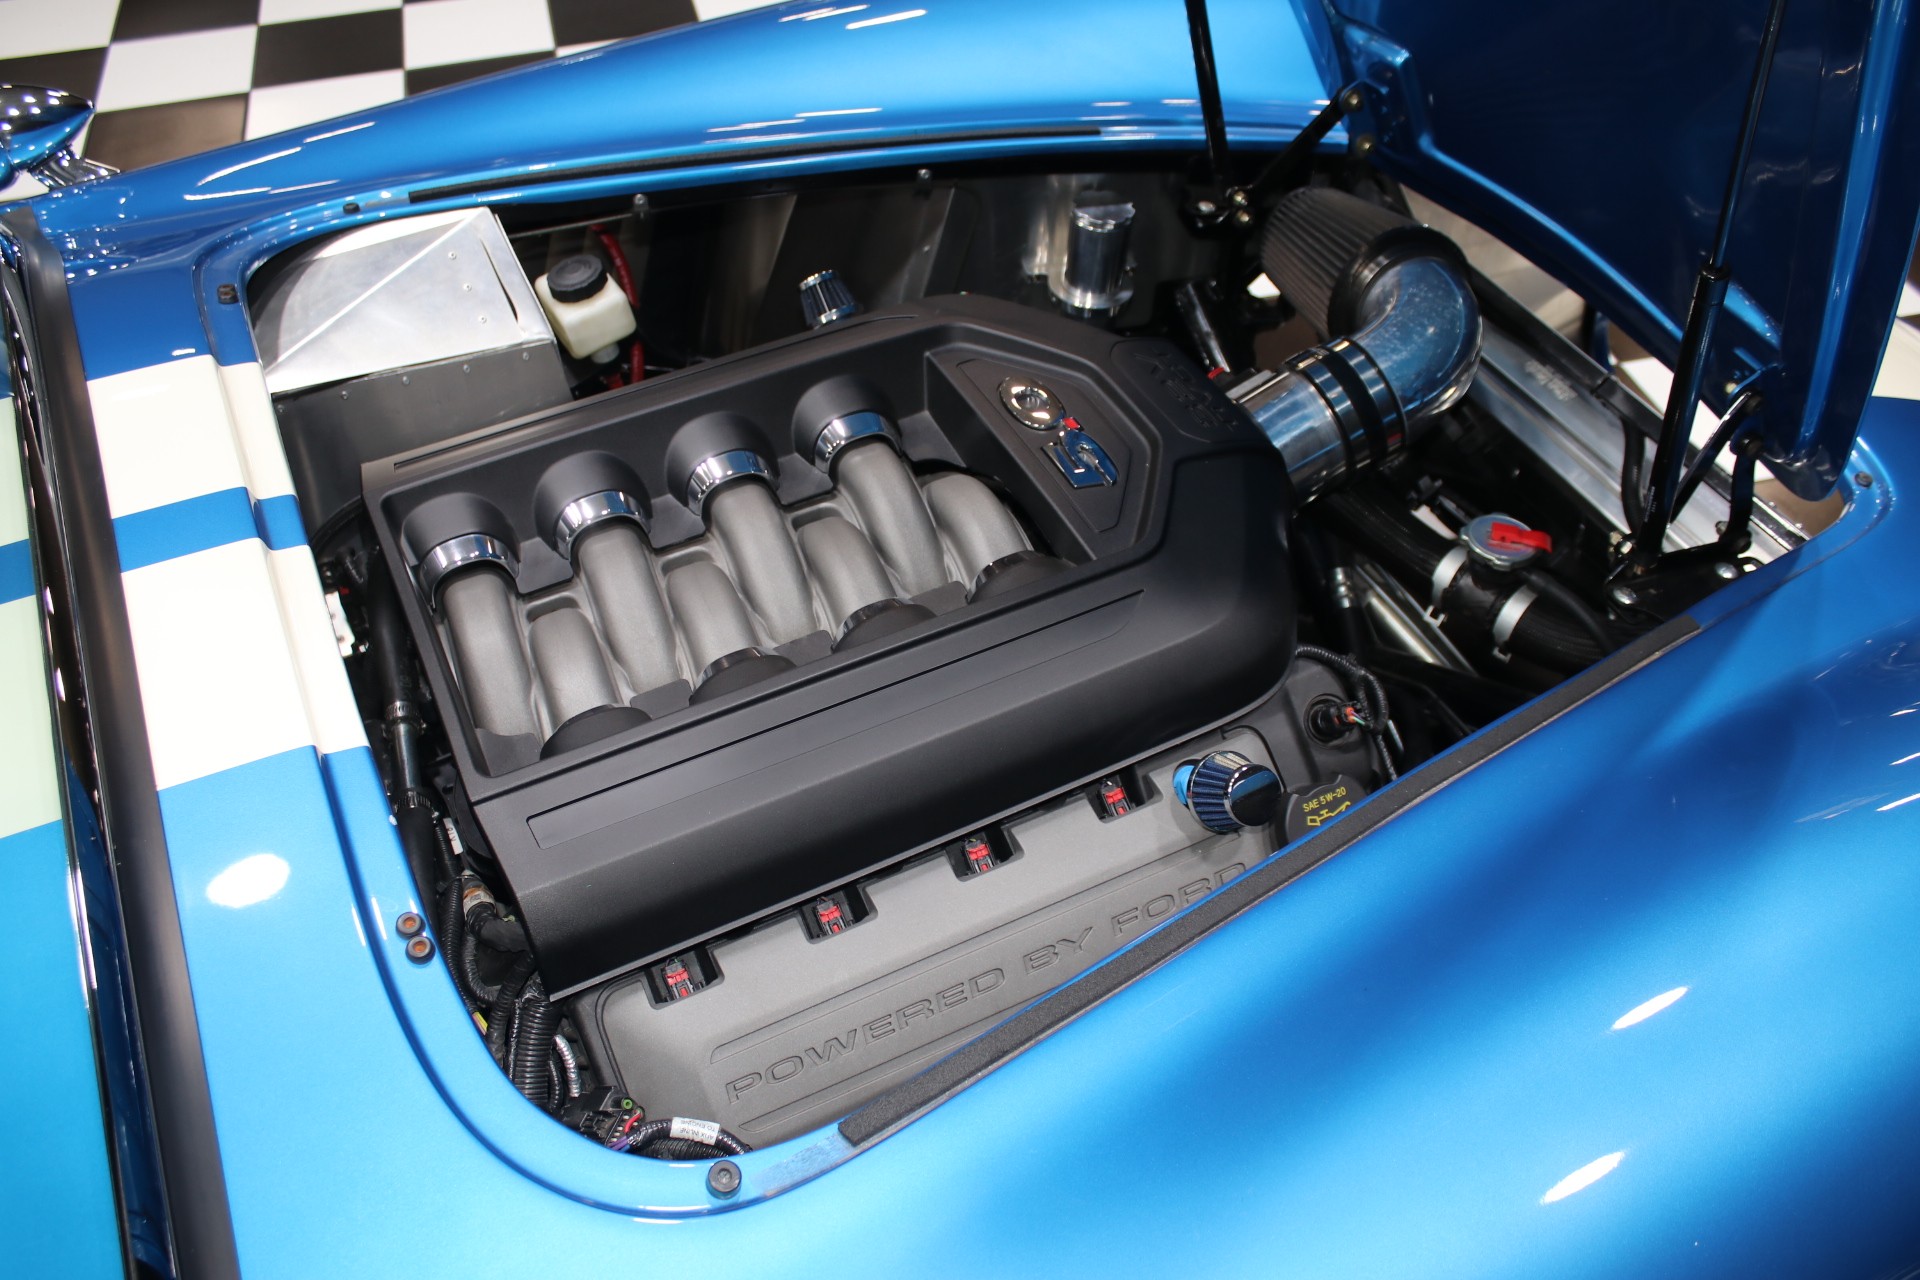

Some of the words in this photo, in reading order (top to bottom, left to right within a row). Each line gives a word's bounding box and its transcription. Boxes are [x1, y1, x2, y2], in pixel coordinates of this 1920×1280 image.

[997, 376, 1120, 488] 5.0
[1302, 799, 1319, 813] SAE
[1320, 786, 1347, 805] 5W-20
[725, 967, 1005, 1105] POWERED
[1023, 926, 1094, 975] BY
[1110, 862, 1246, 938] FORD
